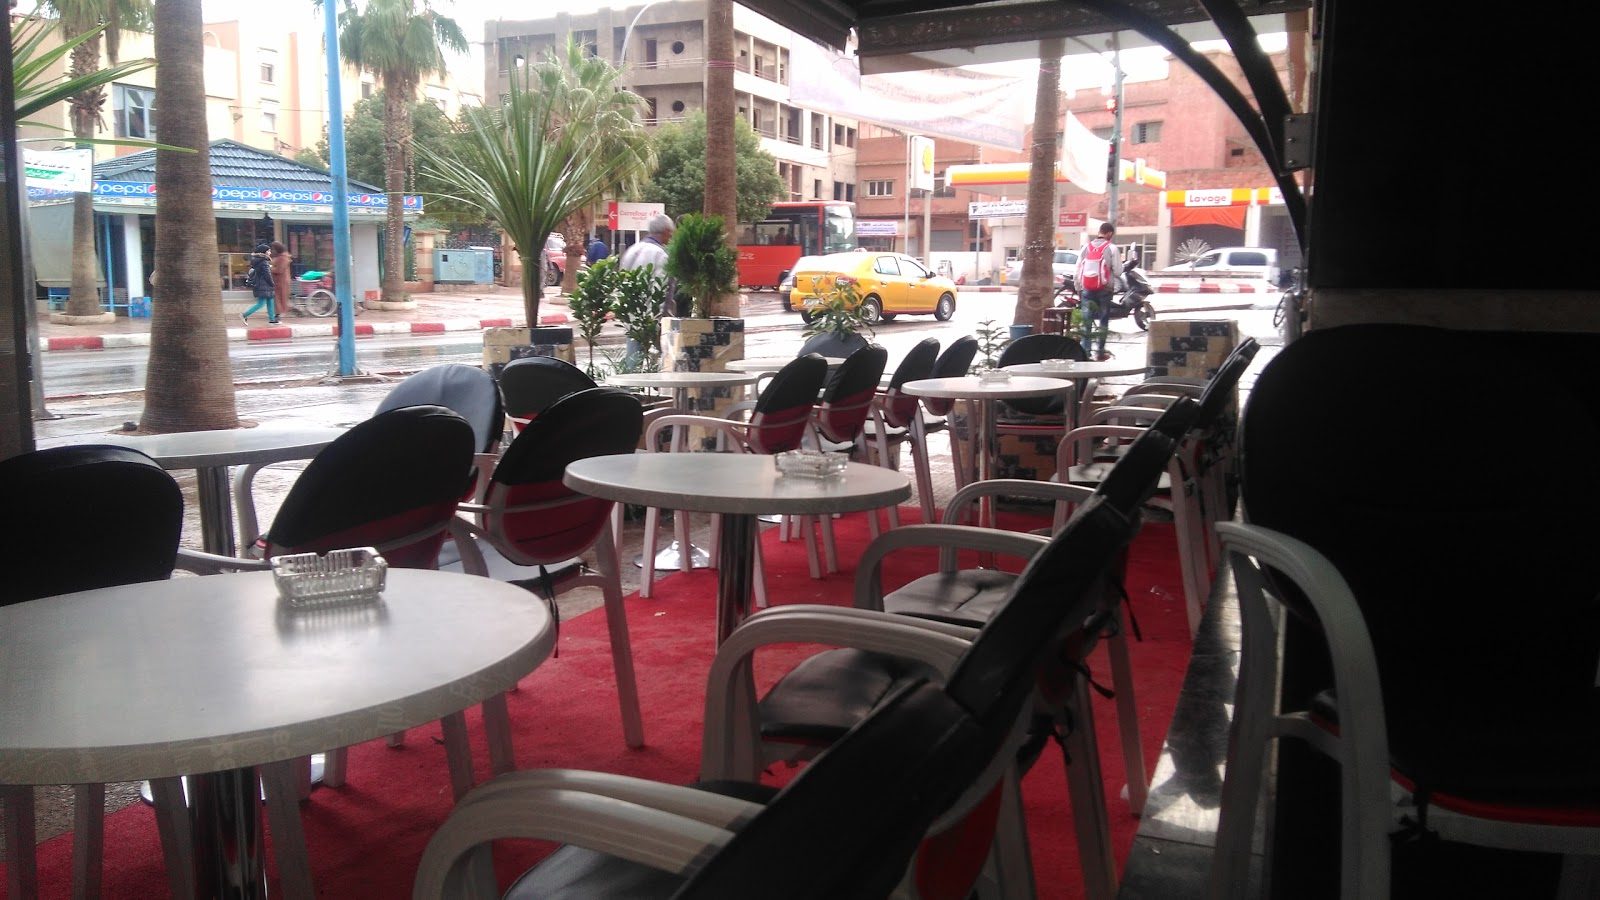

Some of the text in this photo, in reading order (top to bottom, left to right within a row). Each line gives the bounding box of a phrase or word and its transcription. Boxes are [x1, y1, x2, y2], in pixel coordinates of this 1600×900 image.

[101, 184, 147, 195] pepsi
[220, 189, 261, 199] pepsi
[272, 191, 312, 201] pepsi
[1189, 194, 1227, 203] Lavage
